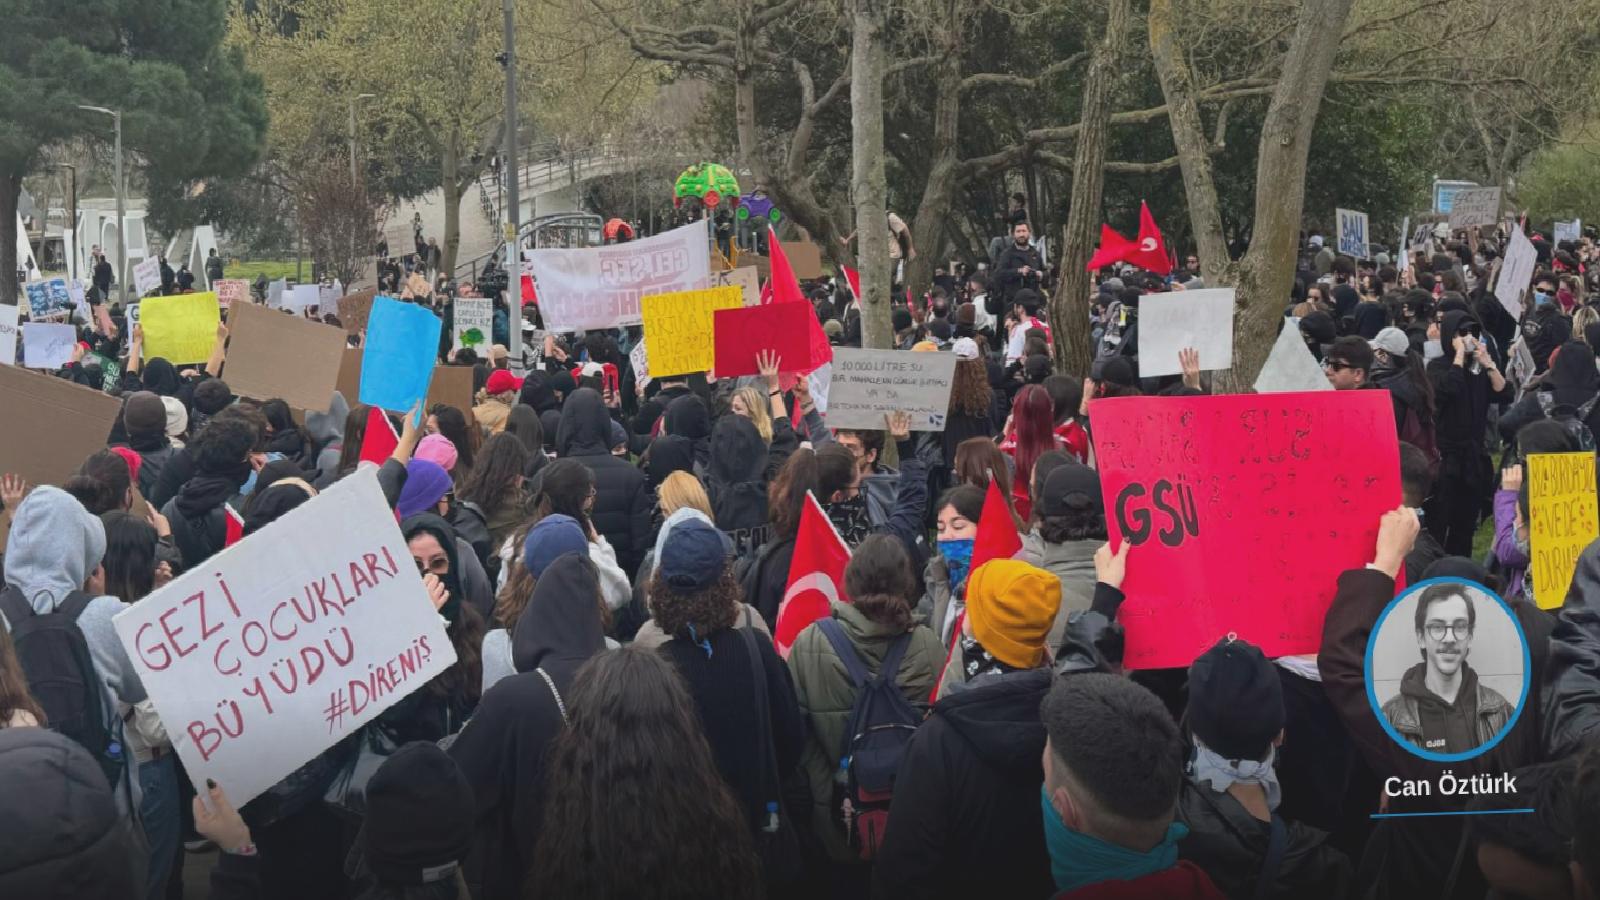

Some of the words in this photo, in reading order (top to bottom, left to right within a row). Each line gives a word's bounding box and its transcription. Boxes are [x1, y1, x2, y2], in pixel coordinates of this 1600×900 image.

[1115, 473, 1200, 547] GSÜ
[134, 572, 242, 671] GEZİ
[213, 546, 400, 677] ÇOCUKLARI
[187, 626, 355, 761] BÜYÜDÜ
[324, 635, 433, 735] #DİRENİŞ
